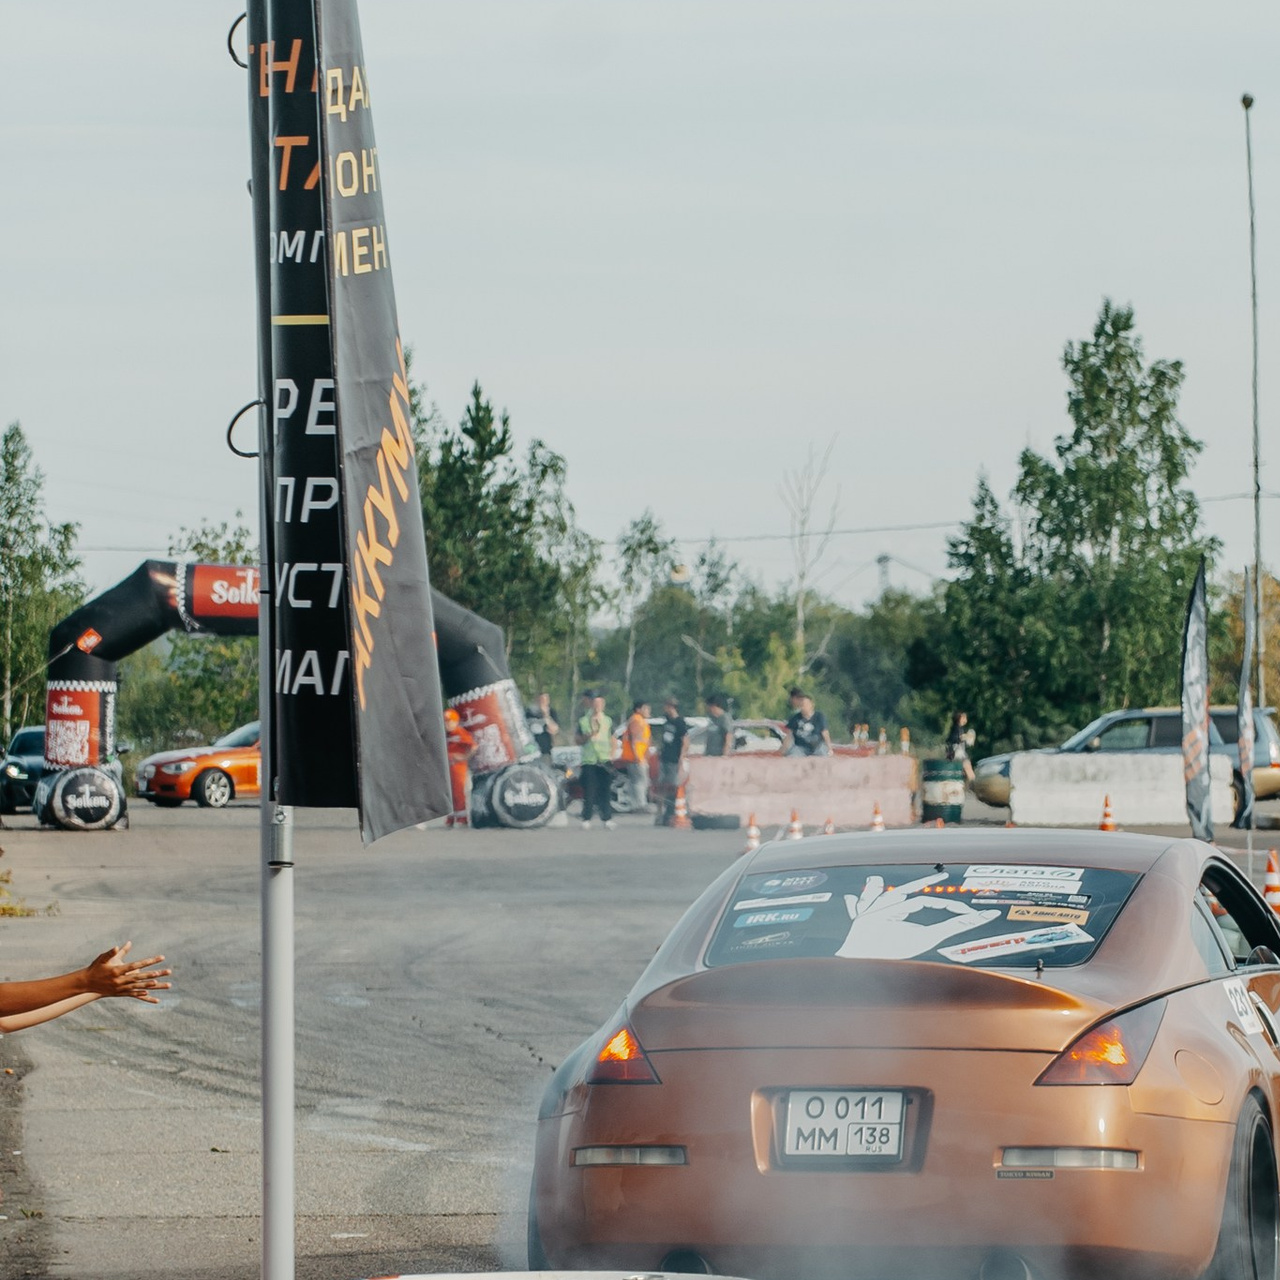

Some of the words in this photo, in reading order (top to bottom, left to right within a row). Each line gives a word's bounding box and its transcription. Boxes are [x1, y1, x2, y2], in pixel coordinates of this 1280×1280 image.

[211, 568, 261, 605] Seik
[746, 912, 801, 925] IRK.RU
[854, 1126, 891, 1146] 138
[865, 1145, 883, 1153] RUS
